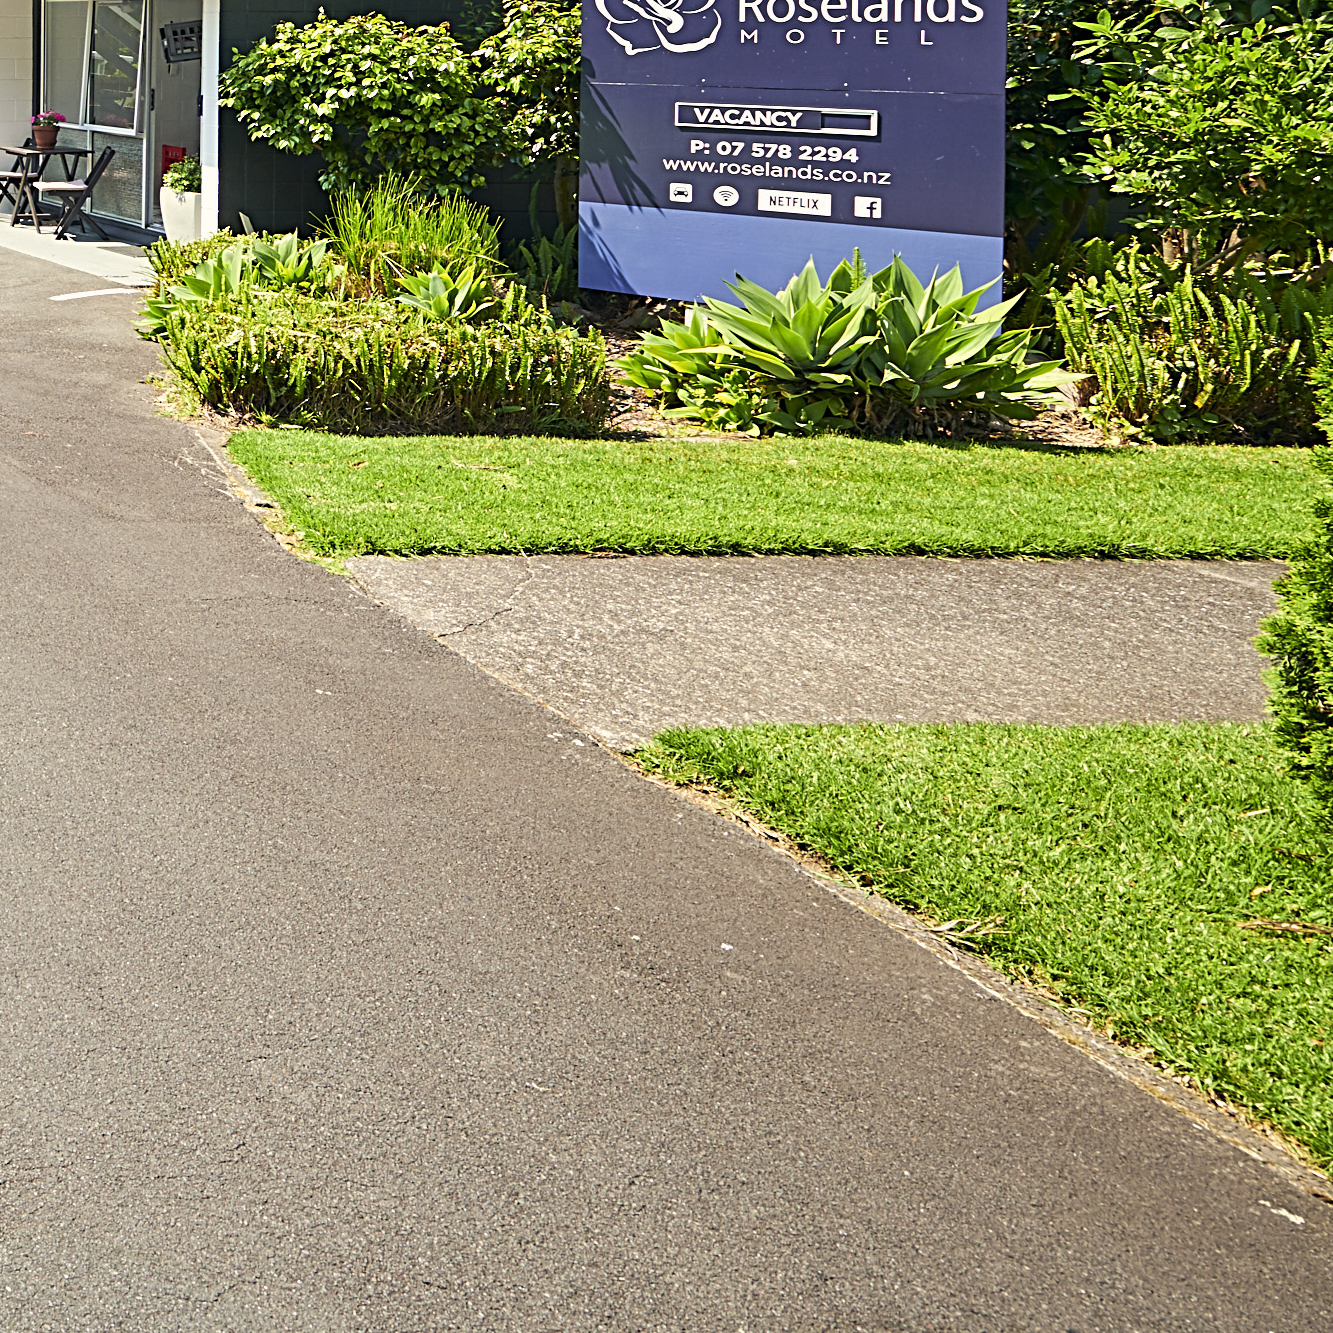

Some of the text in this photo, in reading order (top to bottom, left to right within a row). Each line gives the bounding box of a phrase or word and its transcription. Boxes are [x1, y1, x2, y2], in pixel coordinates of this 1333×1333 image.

[740, 28, 934, 46] MOTEL
[693, 107, 803, 127] VACANCY
[690, 139, 859, 163] P: 07 578 2294
[662, 158, 892, 185] www.roselands.co.nz
[769, 195, 819, 210] NETFLIX
